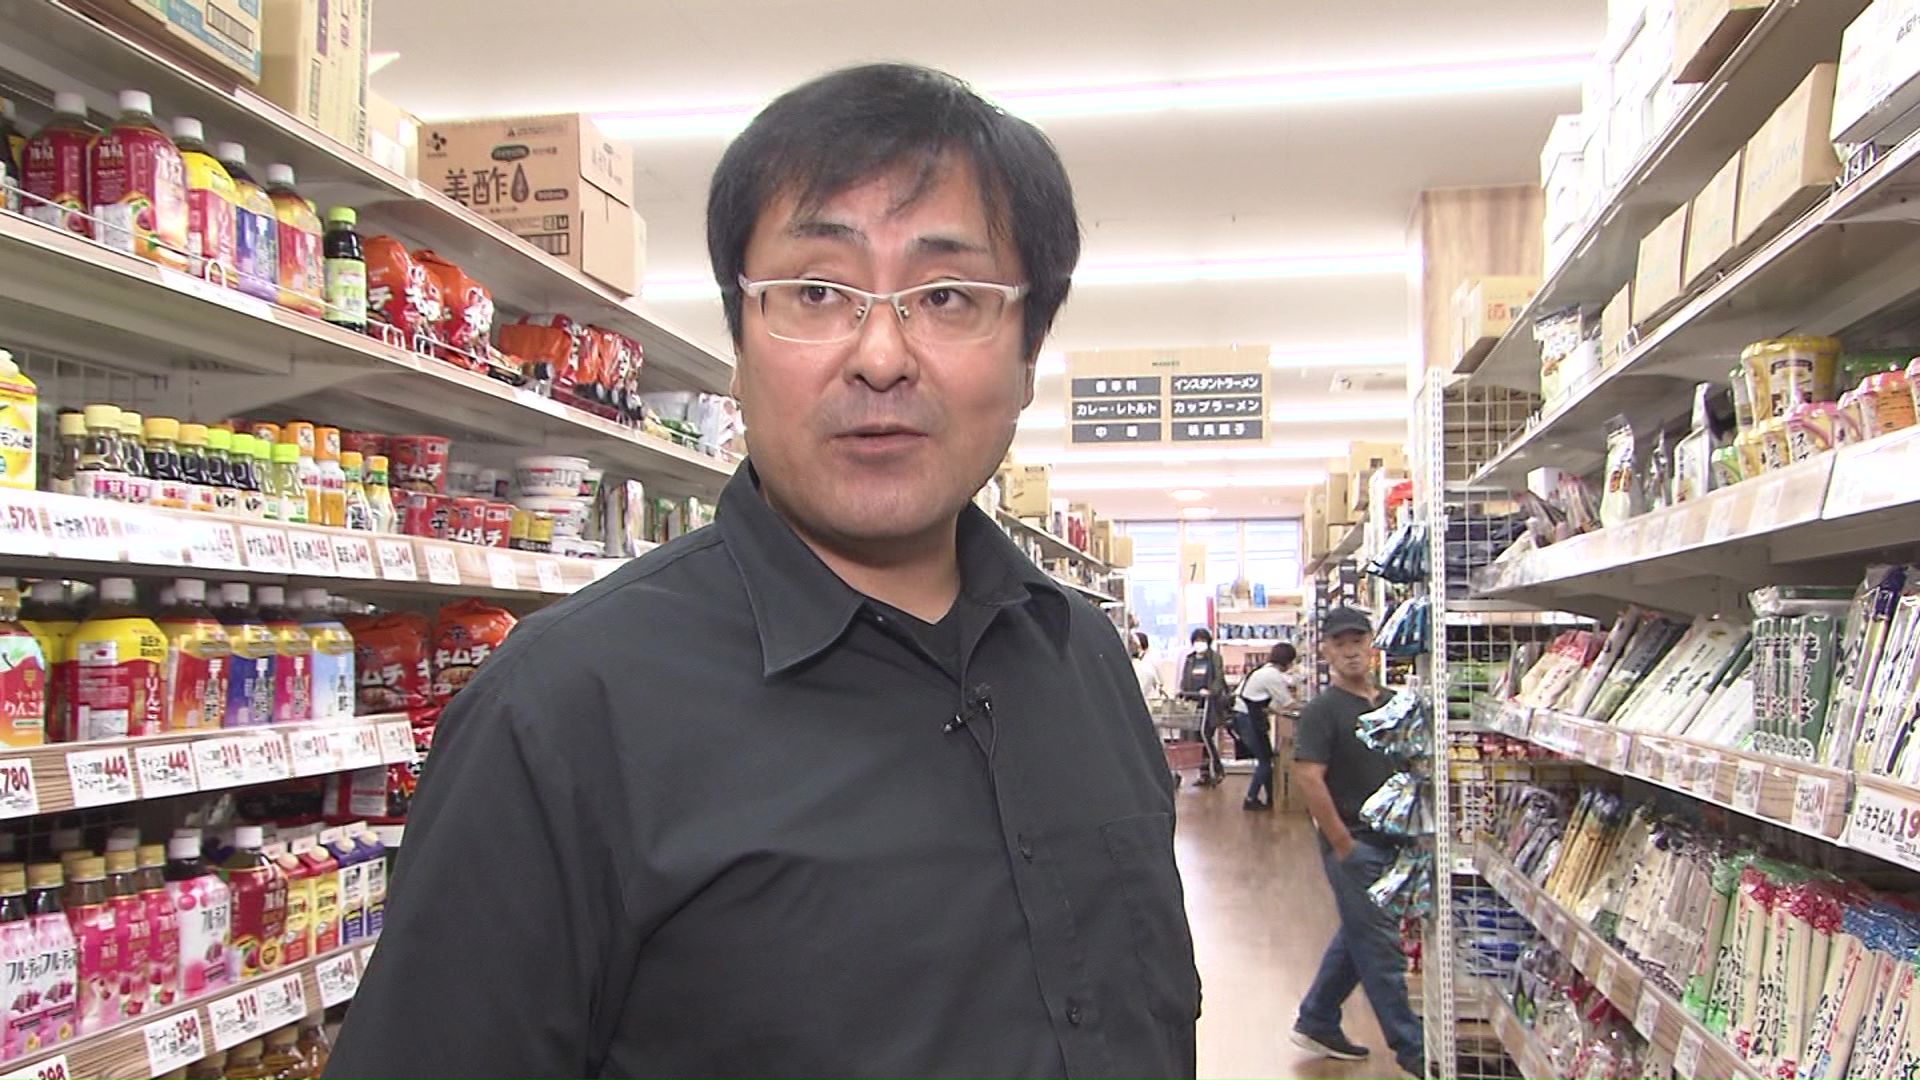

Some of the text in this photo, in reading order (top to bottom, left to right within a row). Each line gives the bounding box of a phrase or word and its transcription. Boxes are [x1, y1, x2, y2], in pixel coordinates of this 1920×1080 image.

[444, 168, 508, 206] 美酢
[1174, 376, 1259, 391] インスタントラーメン
[1076, 403, 1157, 417] カレー・レトルト
[1174, 400, 1259, 414] カップラーメン
[434, 644, 491, 669] キムチ
[104, 755, 128, 778] 448
[168, 749, 189, 771] 448
[1, 766, 29, 794] 780
[175, 1016, 200, 1047] 398
